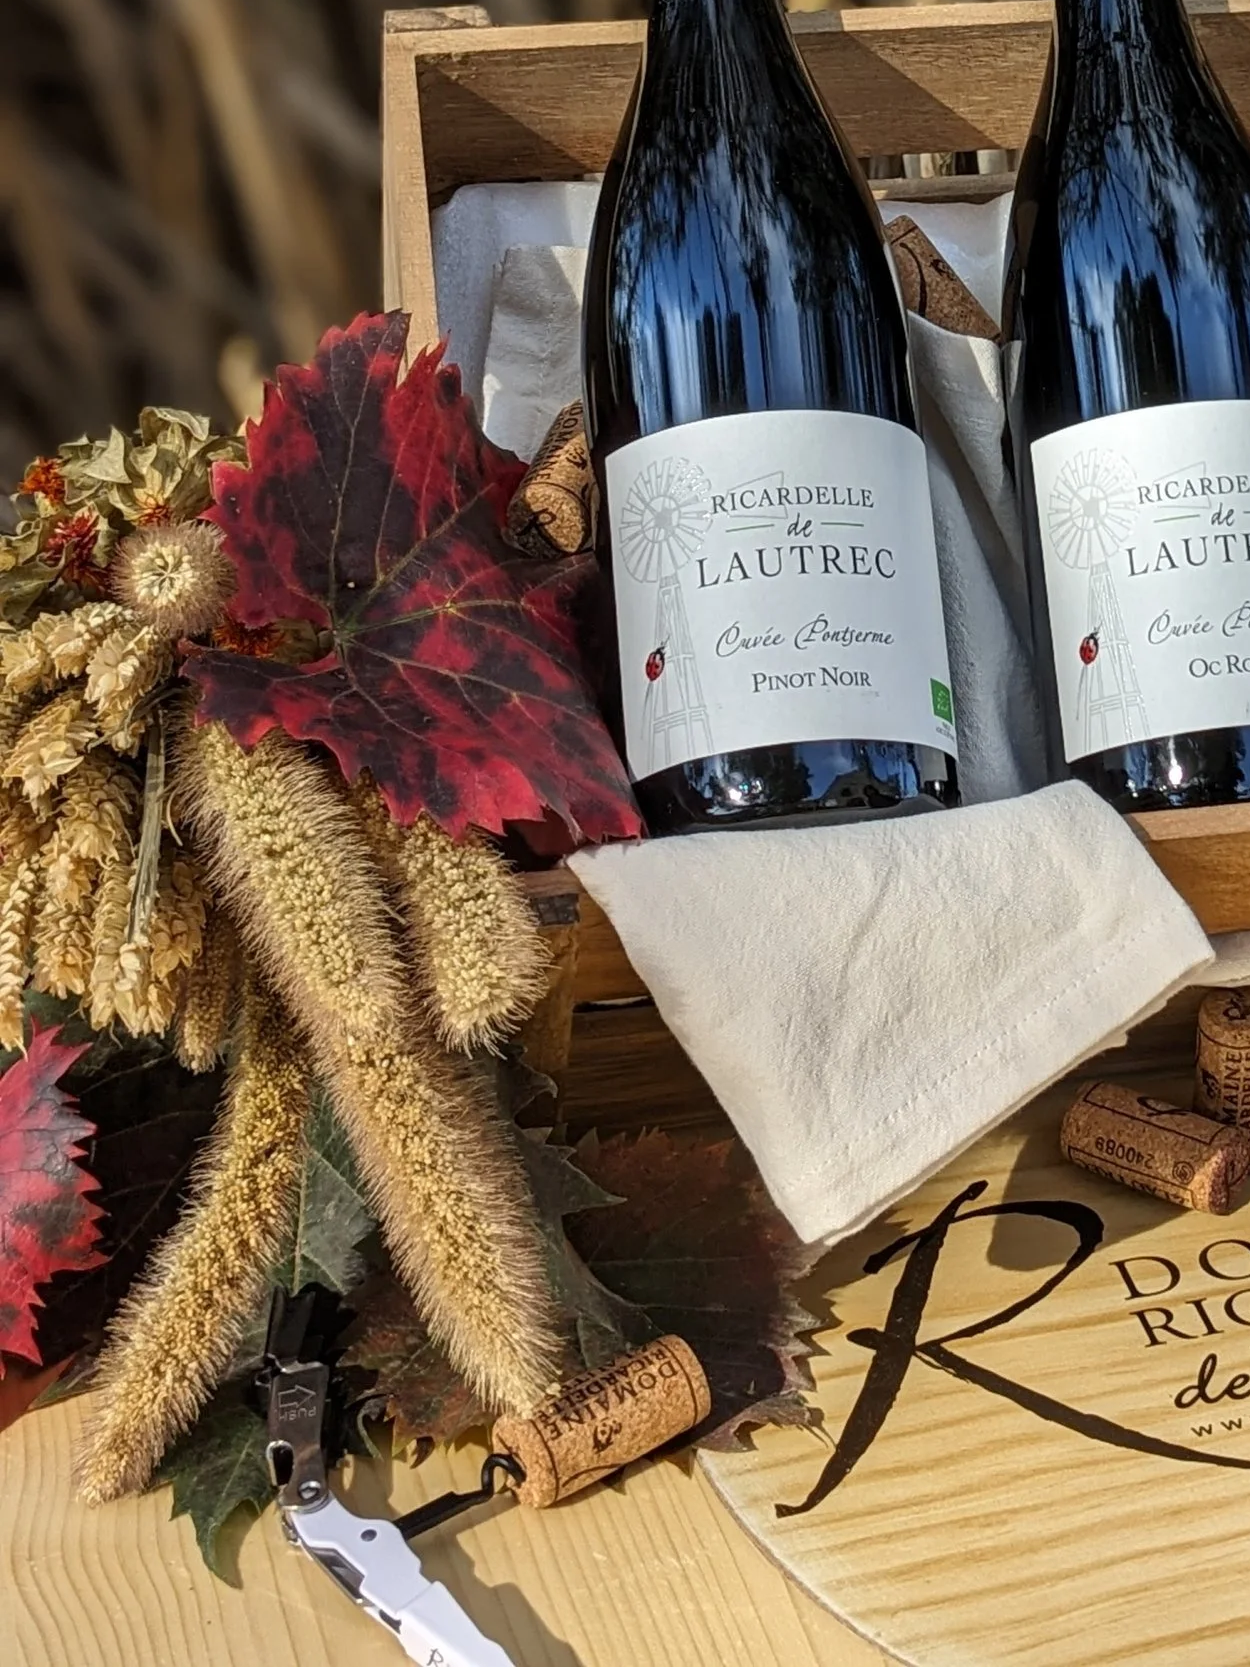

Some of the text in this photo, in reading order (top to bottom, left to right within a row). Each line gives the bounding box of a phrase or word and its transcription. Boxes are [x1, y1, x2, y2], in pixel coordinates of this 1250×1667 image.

[711, 484, 875, 515] RICARDELLE
[1210, 502, 1235, 527] de
[786, 512, 814, 539] de
[696, 544, 897, 589] LAUTREC
[715, 620, 786, 658] Cuvée
[1147, 608, 1214, 645] Cuvée
[751, 665, 873, 694] PINOT NOIR
[1188, 657, 1223, 679] OC
[1095, 1136, 1155, 1170] 240089
[544, 1362, 679, 1442] DOMAINE
